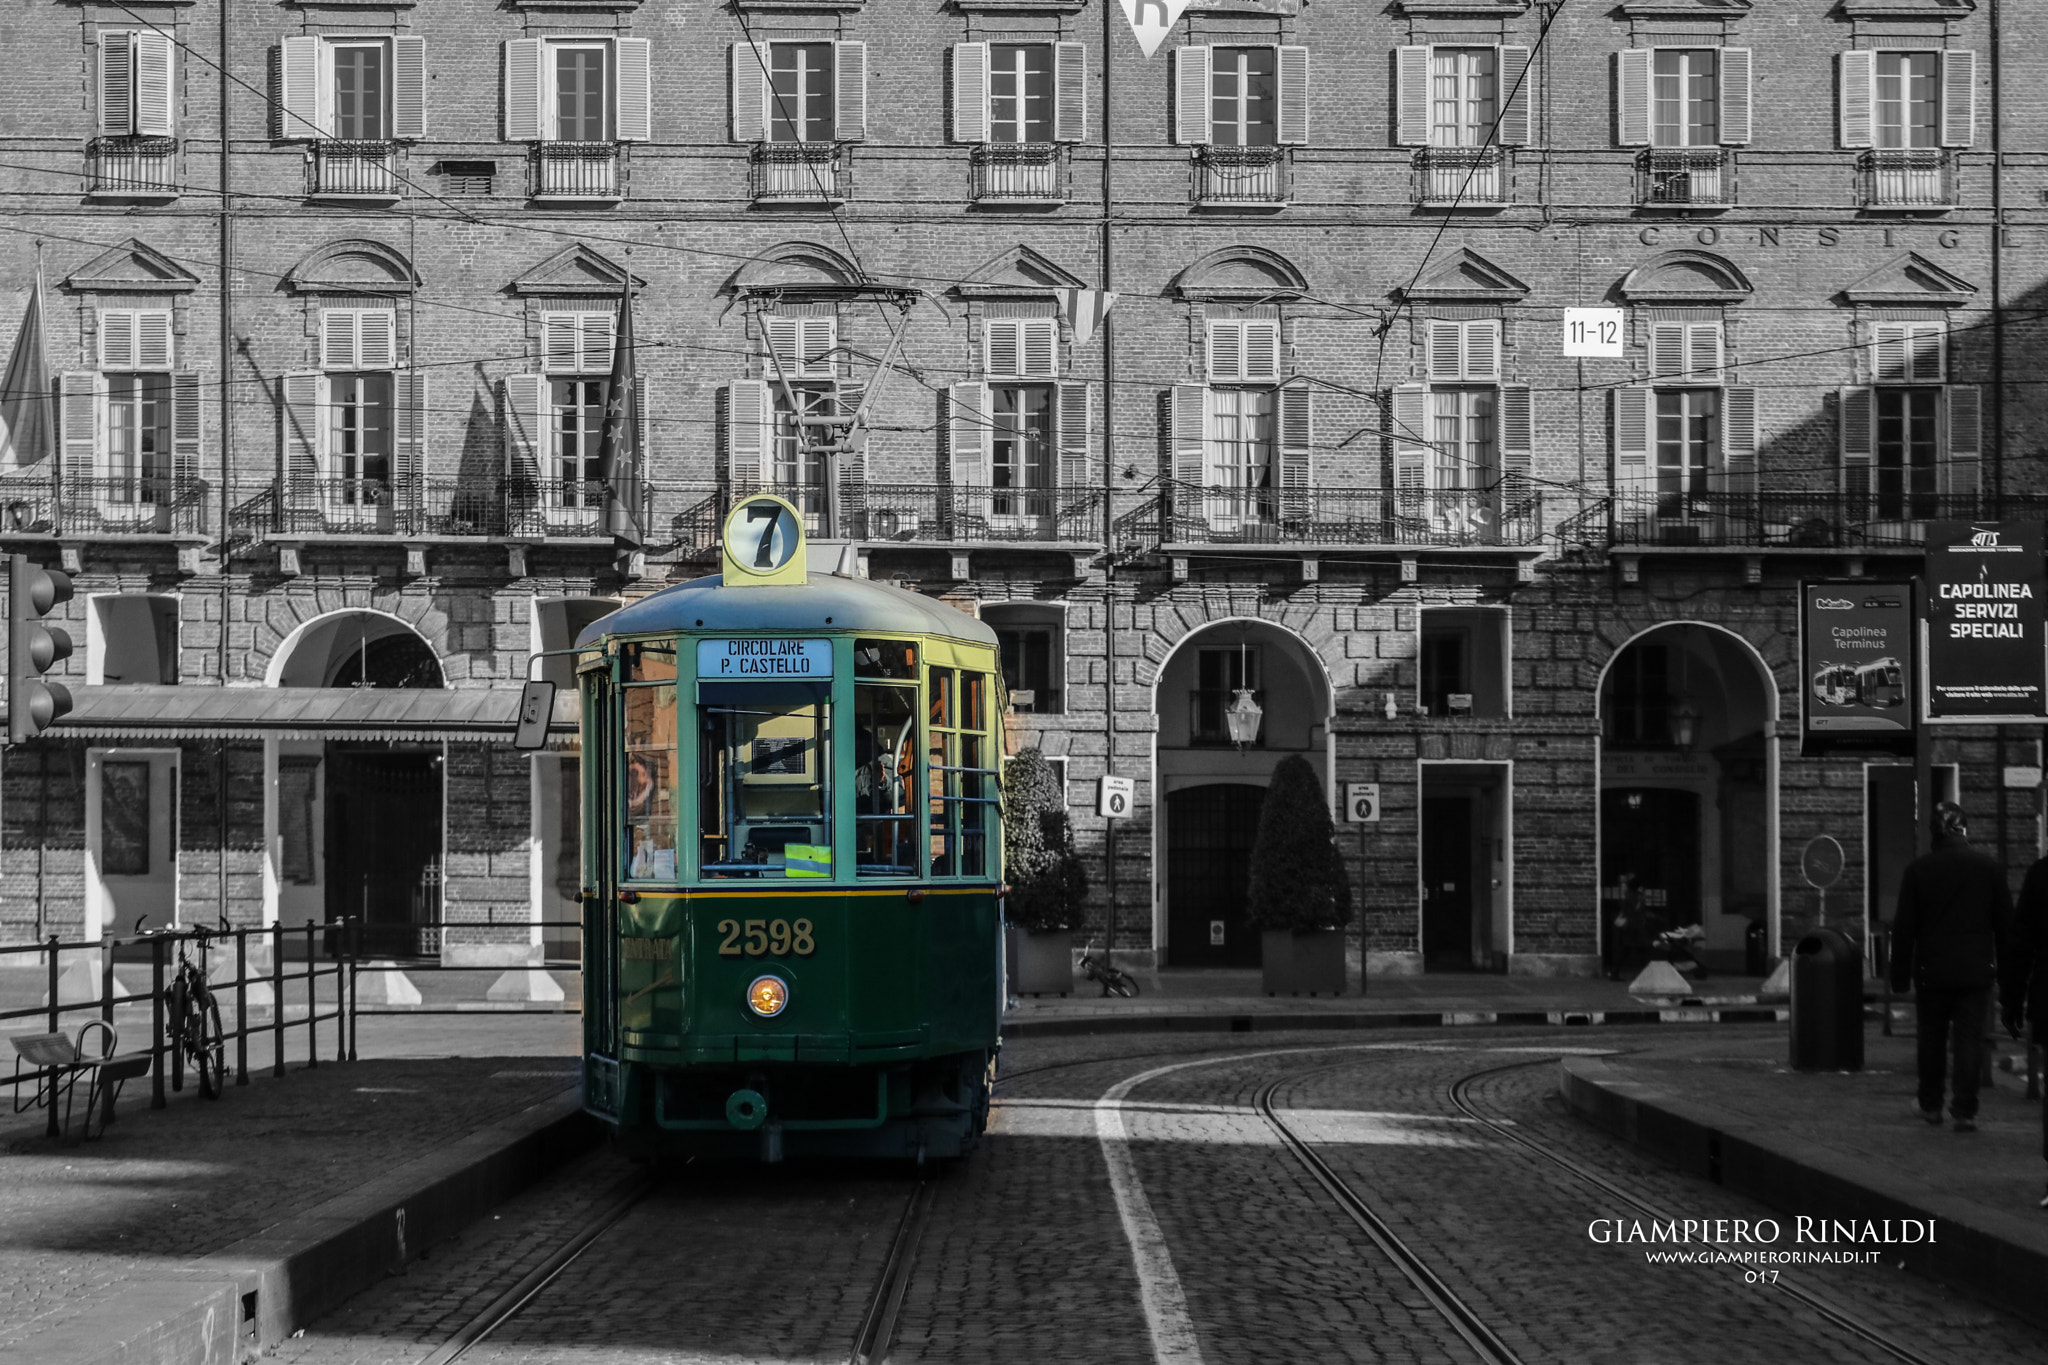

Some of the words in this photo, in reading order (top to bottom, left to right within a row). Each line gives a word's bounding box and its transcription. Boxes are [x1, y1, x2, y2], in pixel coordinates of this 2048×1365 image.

[1570, 320, 1617, 344] 11-12
[747, 506, 782, 567] 7
[1940, 584, 2033, 598] CAPOLINEA
[1955, 604, 2018, 618] SERVIZI
[1831, 626, 1887, 638] Capolinea
[1950, 623, 2023, 638] SPECIALI
[728, 640, 804, 656] CIRCOLARE
[1834, 639, 1886, 649] Terminus
[721, 658, 733, 673] P.
[740, 658, 810, 673] CASTELLO
[717, 918, 815, 956] 2598
